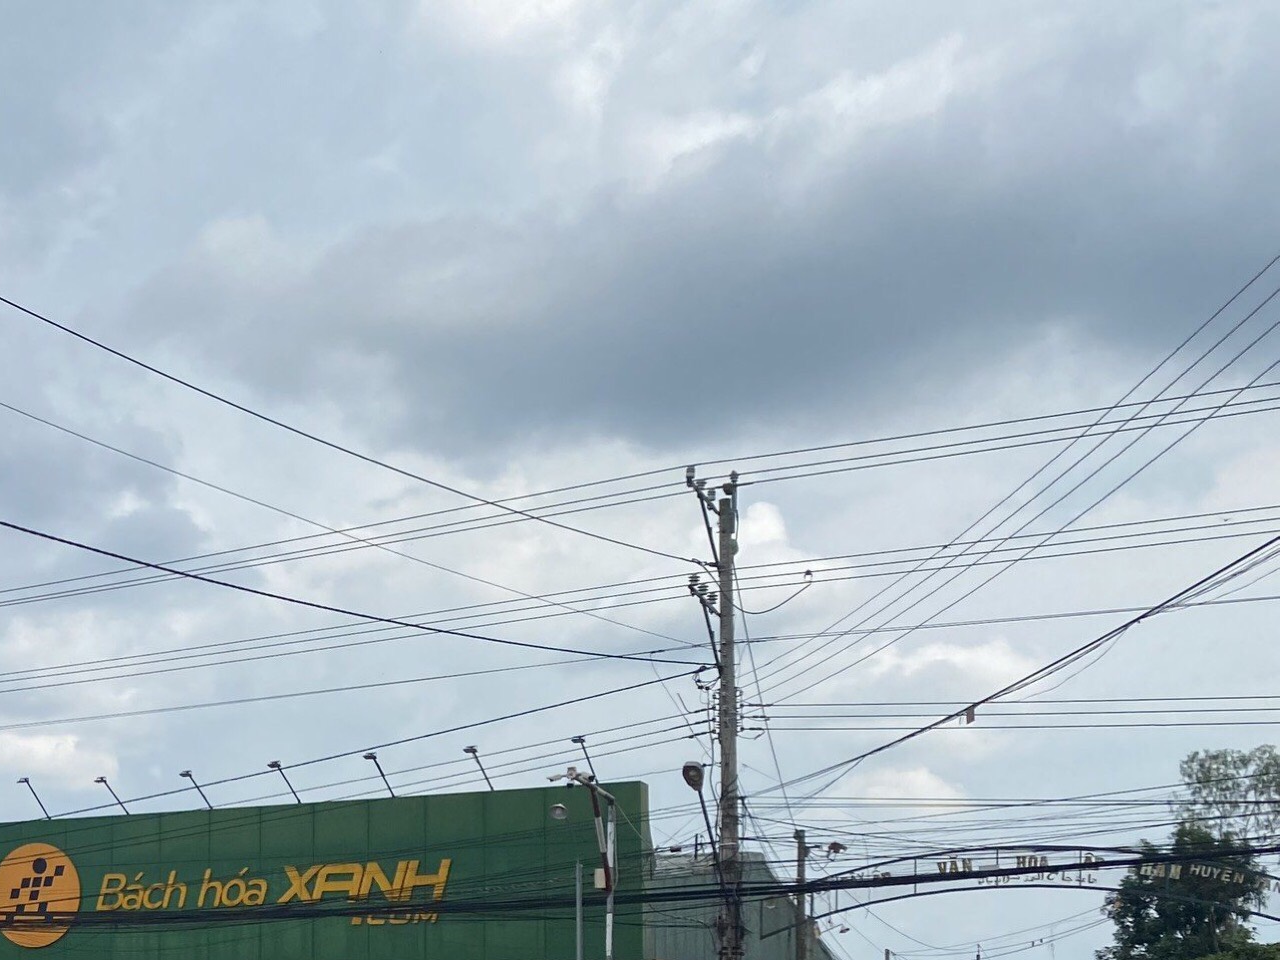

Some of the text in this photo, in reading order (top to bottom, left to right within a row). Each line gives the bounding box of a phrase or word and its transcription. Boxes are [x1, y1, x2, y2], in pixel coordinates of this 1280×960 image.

[95, 858, 452, 912] Bách hóa XANH
